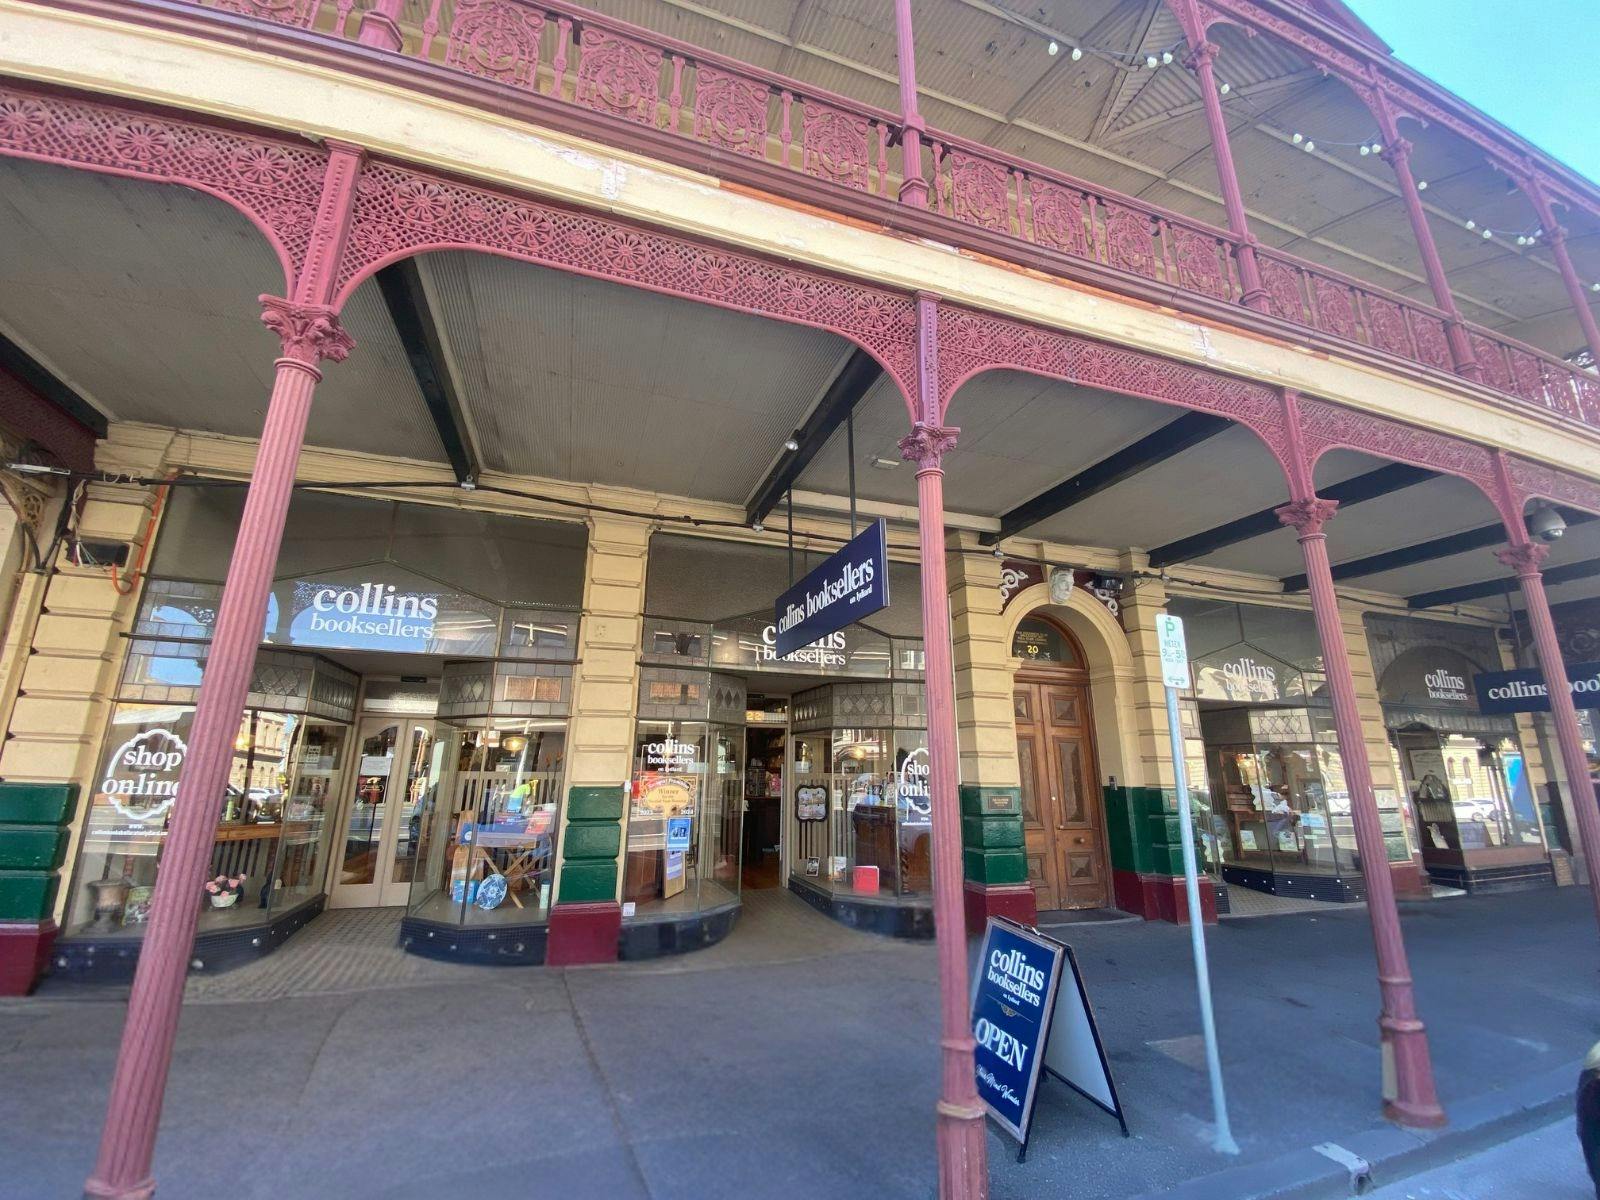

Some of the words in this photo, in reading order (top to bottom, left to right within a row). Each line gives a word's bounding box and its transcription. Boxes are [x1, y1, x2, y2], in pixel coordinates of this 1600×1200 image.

[313, 582, 438, 620] collins
[779, 603, 805, 634] collins
[806, 558, 874, 619] booksellers
[310, 612, 435, 639] booksellers
[1027, 645, 1039, 654] 20
[1223, 657, 1276, 682] collins
[1425, 669, 1465, 690] collins
[1427, 687, 1469, 701] booksellers
[1488, 681, 1548, 700] collins
[123, 745, 182, 771] shop
[647, 739, 695, 755] collins
[647, 755, 694, 764] booksellers
[907, 760, 930, 776] sho
[900, 780, 931, 797] onli
[990, 949, 1045, 991] collins
[987, 965, 1041, 1007] booksellers
[975, 1018, 1029, 1072] OPEN
